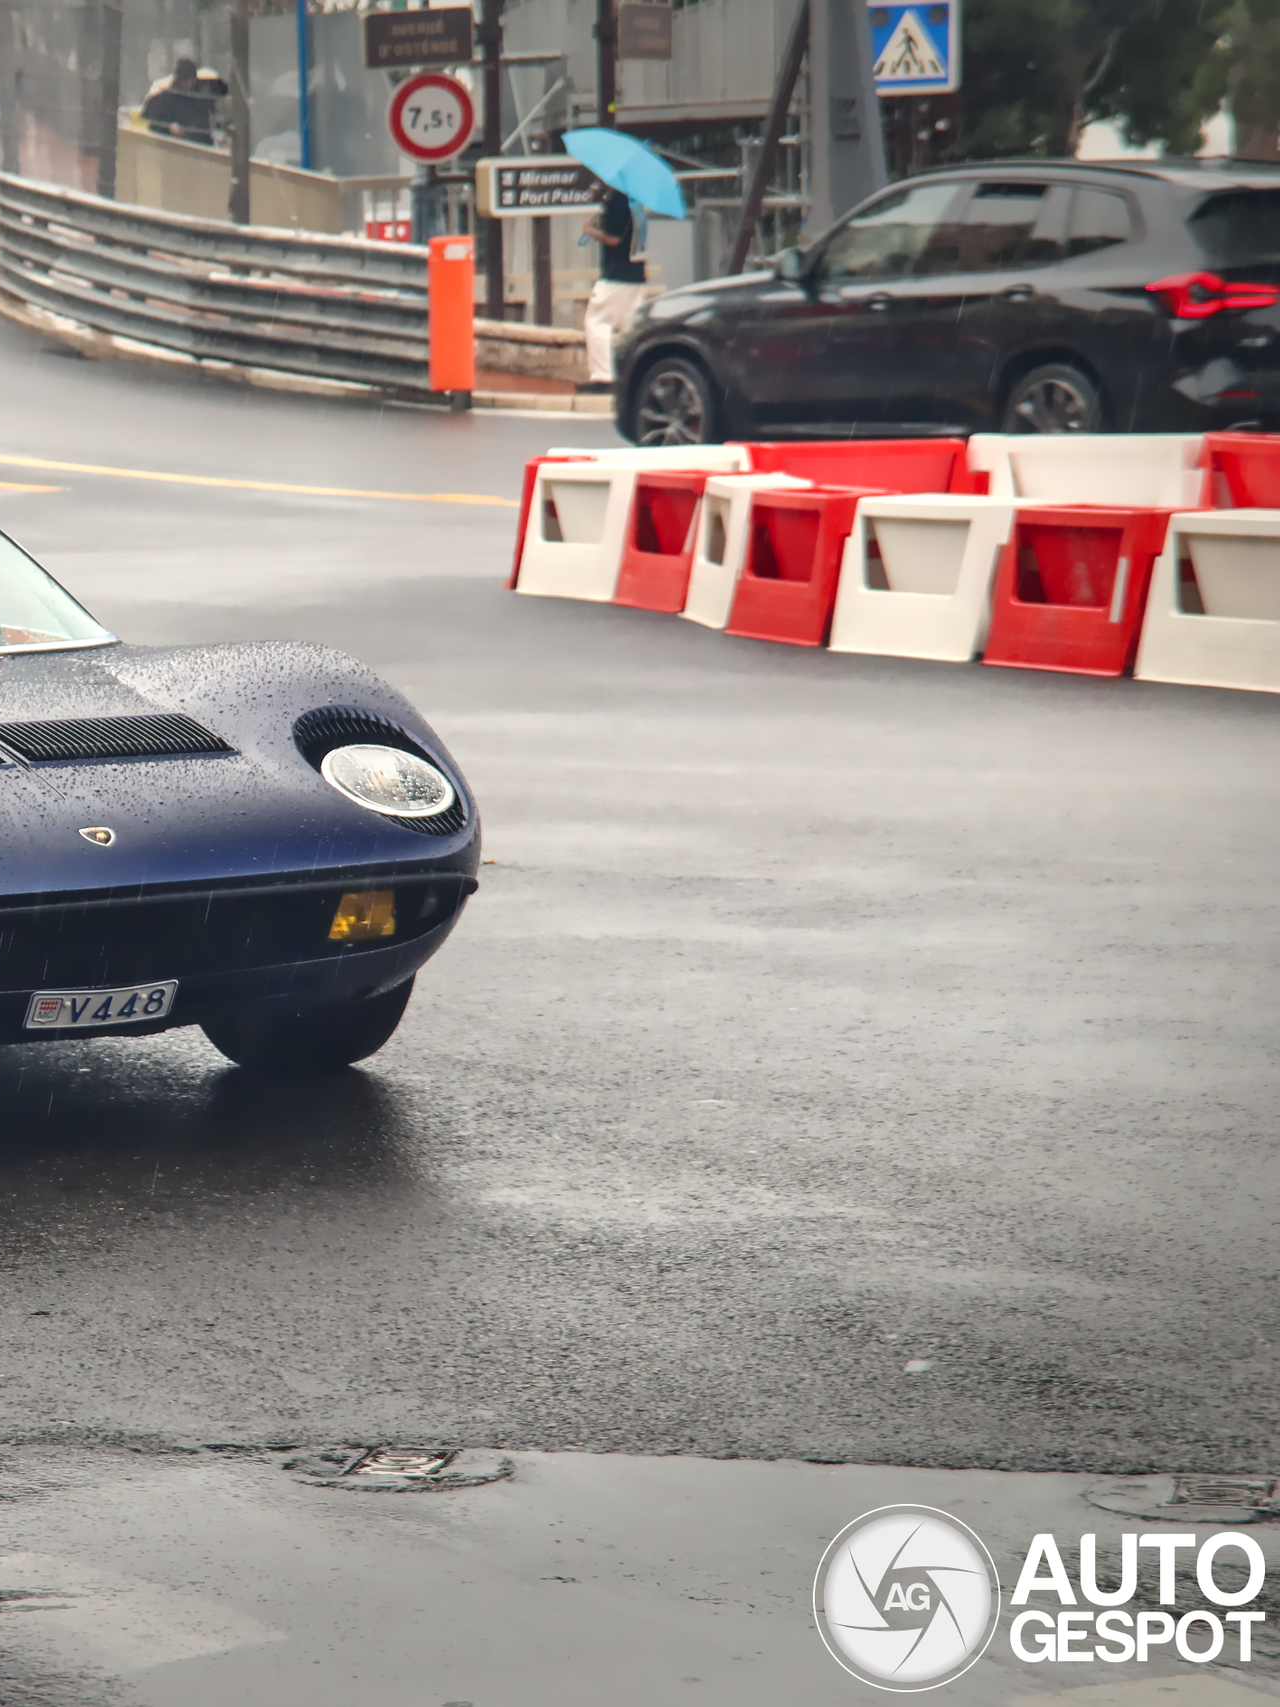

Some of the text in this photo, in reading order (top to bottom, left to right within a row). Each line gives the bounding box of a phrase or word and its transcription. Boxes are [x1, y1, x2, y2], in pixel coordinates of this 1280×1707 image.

[519, 171, 576, 186] Miramar
[519, 190, 594, 204] Port Palac
[71, 988, 166, 1023] V448
[37, 1011, 54, 1019] MC
